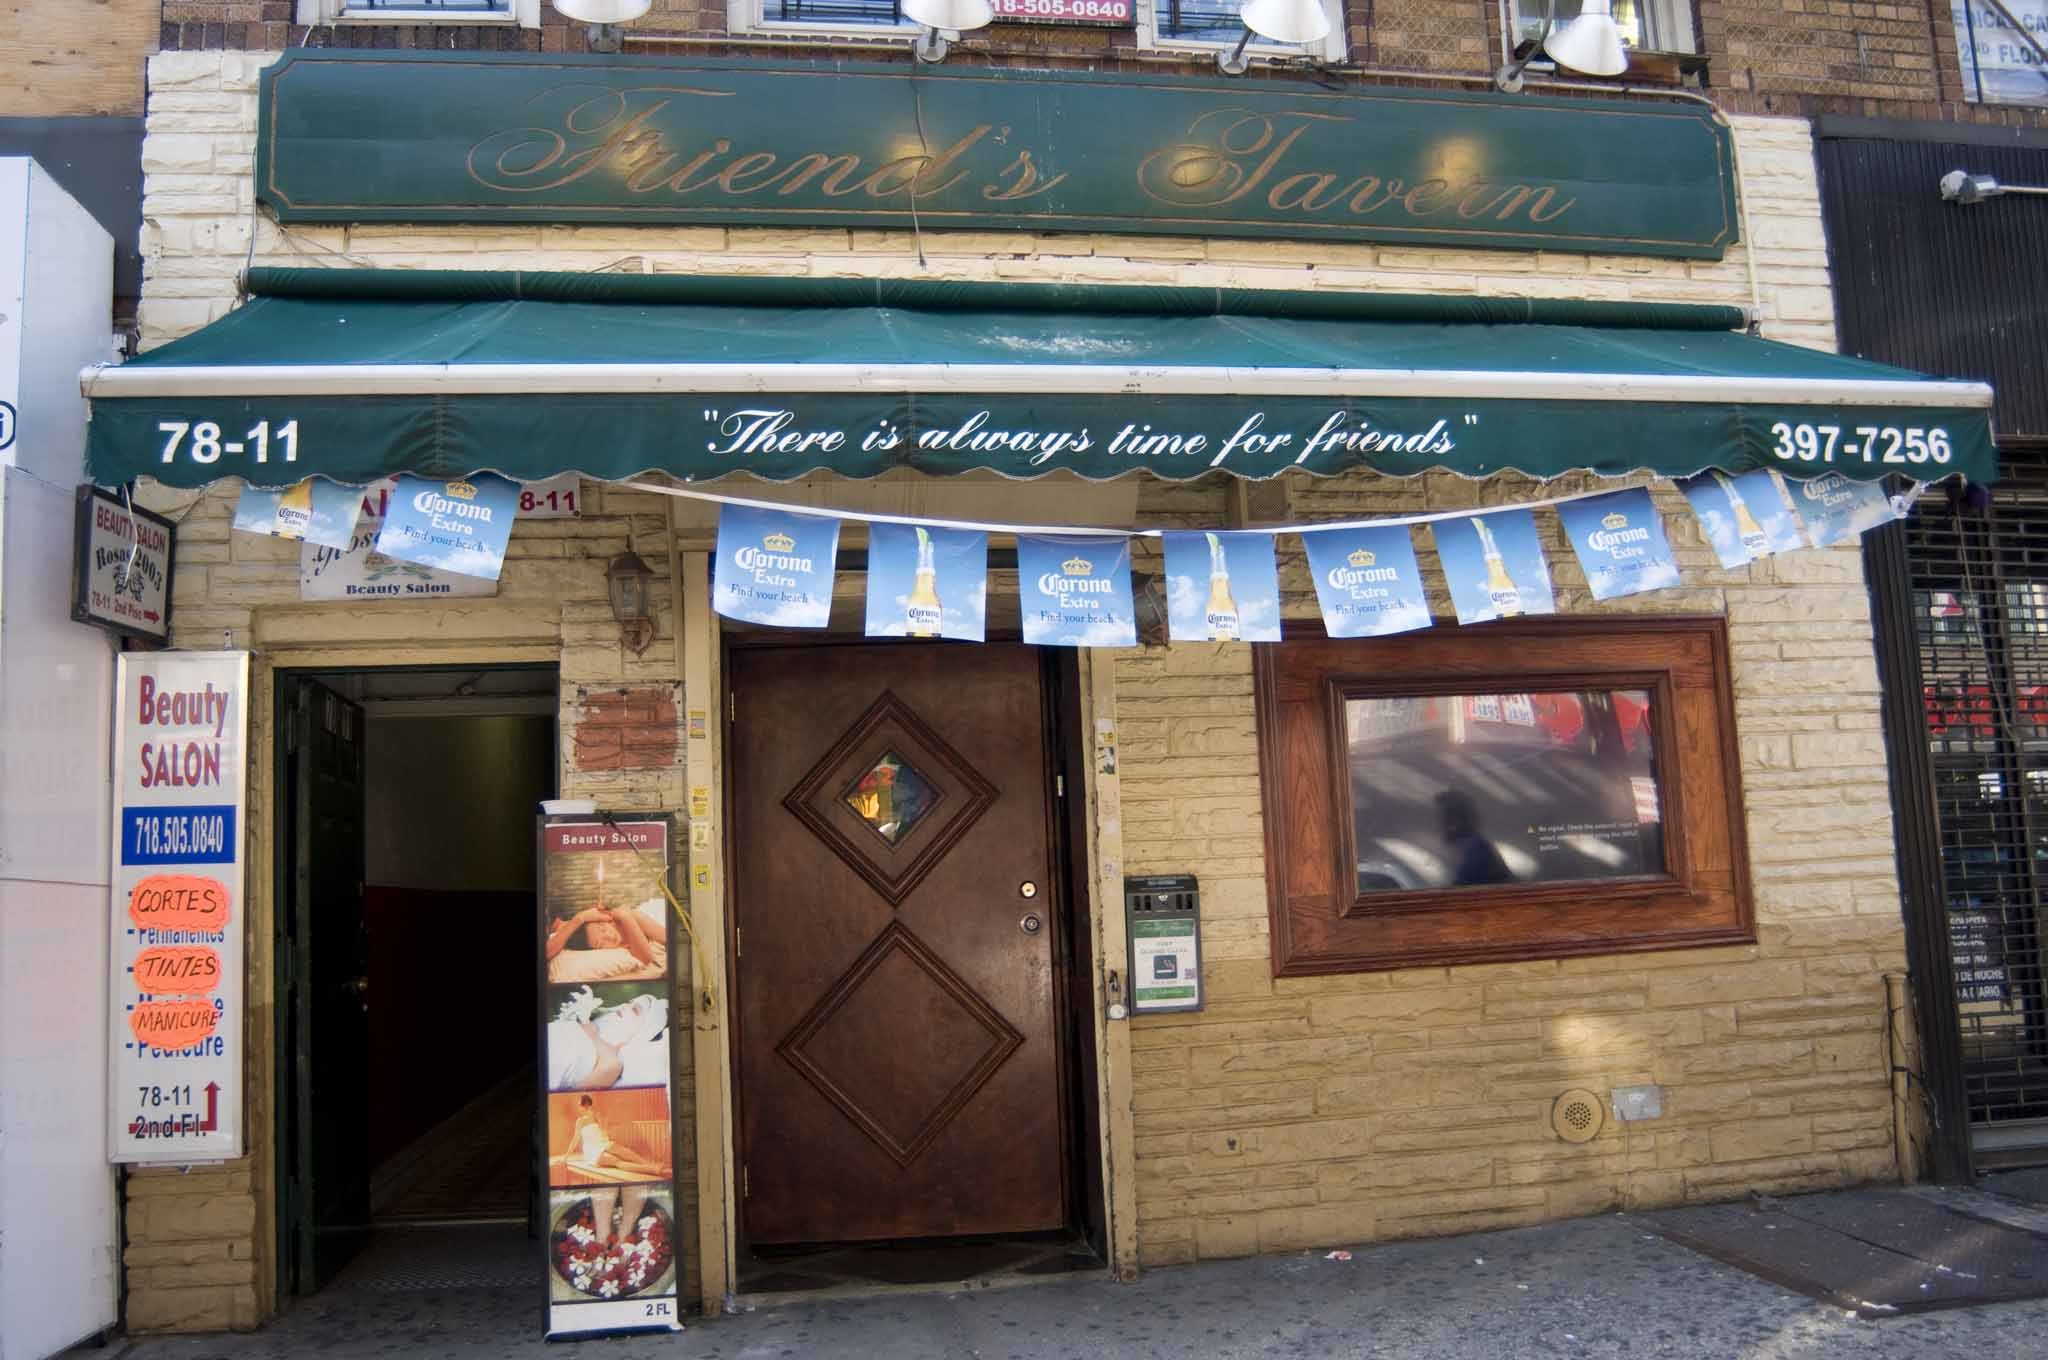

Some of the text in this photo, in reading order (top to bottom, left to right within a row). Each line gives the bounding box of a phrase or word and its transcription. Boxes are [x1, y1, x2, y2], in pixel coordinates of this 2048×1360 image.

[993, 0, 1127, 17] 18-505-0840
[467, 84, 1068, 199] Friend's
[1136, 107, 1577, 222] Tavern
[159, 420, 298, 463] 78-11
[861, 419, 904, 452] is
[918, 410, 1095, 466] always
[1107, 423, 1207, 455] time
[1209, 412, 1292, 467] for
[1771, 422, 1951, 464] 397-7256
[412, 490, 494, 525] Corona
[519, 490, 576, 512] 8-11
[96, 505, 166, 553] BEAUTY SALON
[403, 525, 427, 540] Find
[428, 533, 453, 548] your
[431, 515, 474, 537] Extra
[1587, 527, 1650, 552] Corona
[734, 545, 815, 574] Corona
[345, 581, 451, 596] Beauty Salon
[754, 570, 797, 588] Extra
[1038, 573, 1113, 599] Corona
[1327, 567, 1399, 592] Corona
[92, 591, 111, 609] 78-11
[731, 583, 753, 598] Find
[756, 589, 778, 602] your
[1060, 593, 1099, 609] Extra
[1350, 586, 1389, 601] Extra
[1040, 609, 1062, 623] Find
[1064, 614, 1085, 626] your
[139, 675, 229, 737] Beauty
[140, 742, 221, 788] SALON
[136, 815, 224, 855] 718.505.0840
[562, 832, 648, 846] Beauty Salon
[137, 888, 218, 914] CORTES
[144, 955, 217, 978] TINTES
[137, 1009, 219, 1033] MANICURE
[139, 1085, 191, 1106] 78-11
[135, 1115, 174, 1139] 2nd
[646, 1303, 671, 1316] 2 FL
